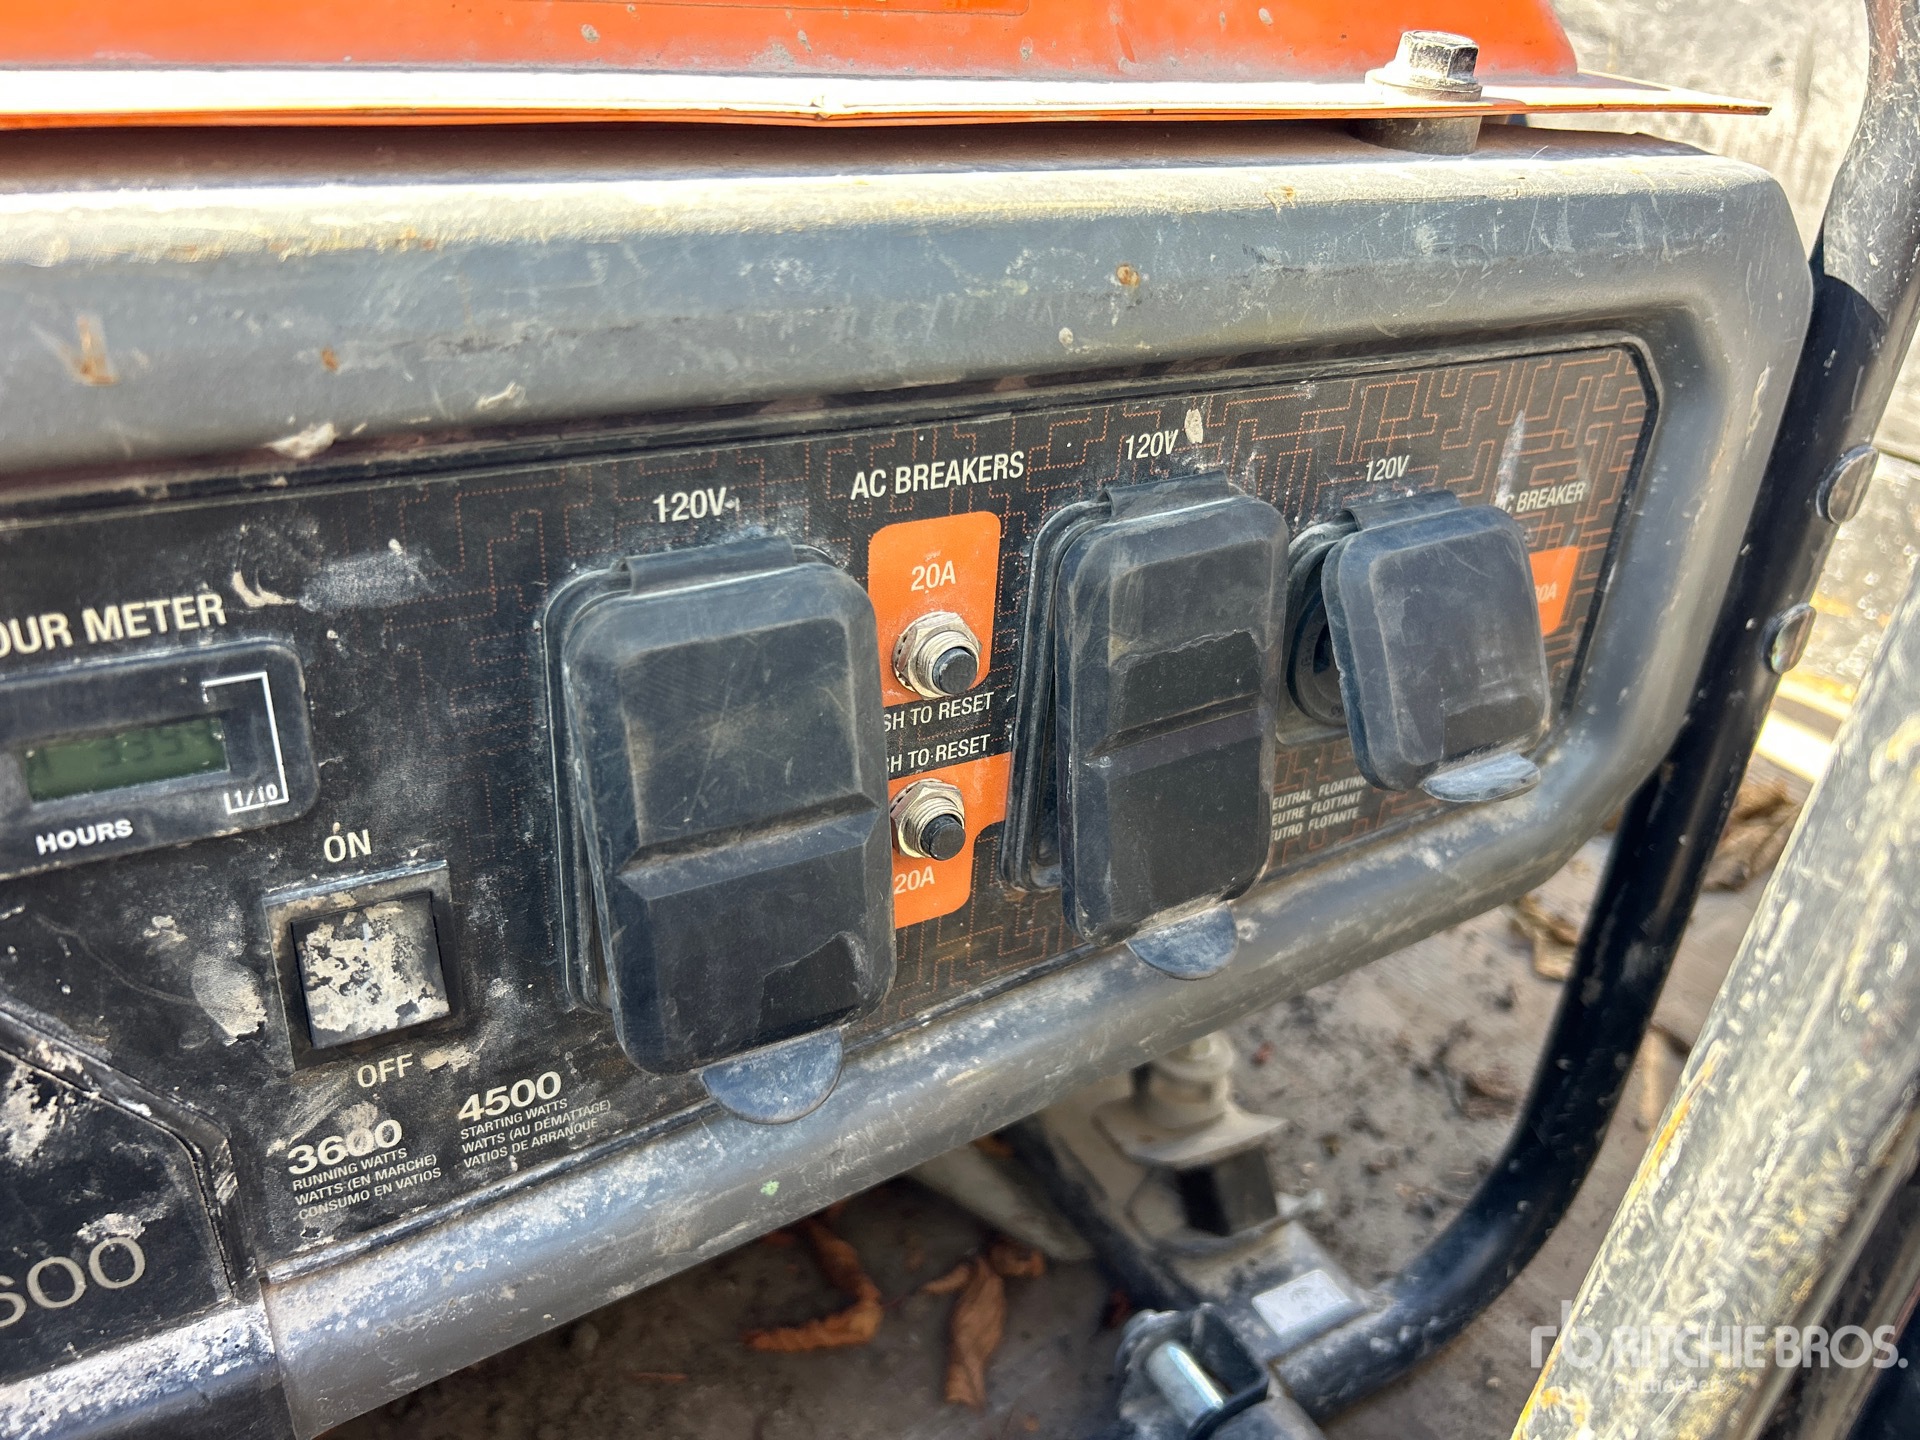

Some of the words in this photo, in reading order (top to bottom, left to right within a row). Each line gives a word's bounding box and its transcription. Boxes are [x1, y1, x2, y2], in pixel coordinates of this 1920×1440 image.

[1125, 429, 1179, 460] 120V
[850, 469, 887, 500] AC
[895, 451, 1024, 494] BREAKERS
[1365, 455, 1410, 483] 120V
[653, 487, 728, 523] 120V
[1516, 481, 1587, 512] BREAKER
[911, 560, 956, 593] 20A
[82, 593, 226, 643] METER
[884, 711, 905, 732] SH
[910, 706, 932, 726] TO
[939, 692, 994, 720] RESET
[908, 748, 929, 768] TO
[936, 734, 990, 762] RESET
[234, 783, 278, 807] 1/10
[1272, 805, 1306, 826] EUTRE
[1311, 791, 1363, 814] FLOTTANT
[1273, 789, 1311, 810] EUTRAL
[36, 819, 133, 854] HOURS
[1308, 807, 1359, 831] FLOTANTE
[324, 829, 371, 862] ON
[894, 866, 935, 895] 20A
[357, 1053, 413, 1088] OFF
[458, 1072, 562, 1122] 4500
[460, 1110, 523, 1140] STARTING
[526, 1098, 568, 1119] WATTS
[287, 1119, 403, 1174] 3600
[462, 1131, 506, 1154] WATTS
[509, 1124, 531, 1146] (AU
[464, 1146, 508, 1168] VATIOS
[511, 1139, 528, 1154] DE
[531, 1117, 598, 1148] ARRANQUE
[292, 1160, 358, 1191] RUNNING
[361, 1148, 407, 1170] WATTS
[295, 1184, 344, 1206] WATTS
[347, 1173, 372, 1192] (EN
[375, 1153, 437, 1181] MARCHE)
[298, 1189, 370, 1221] CONSUMO
[374, 1183, 392, 1198] EN
[395, 1168, 441, 1192] VATIOS
